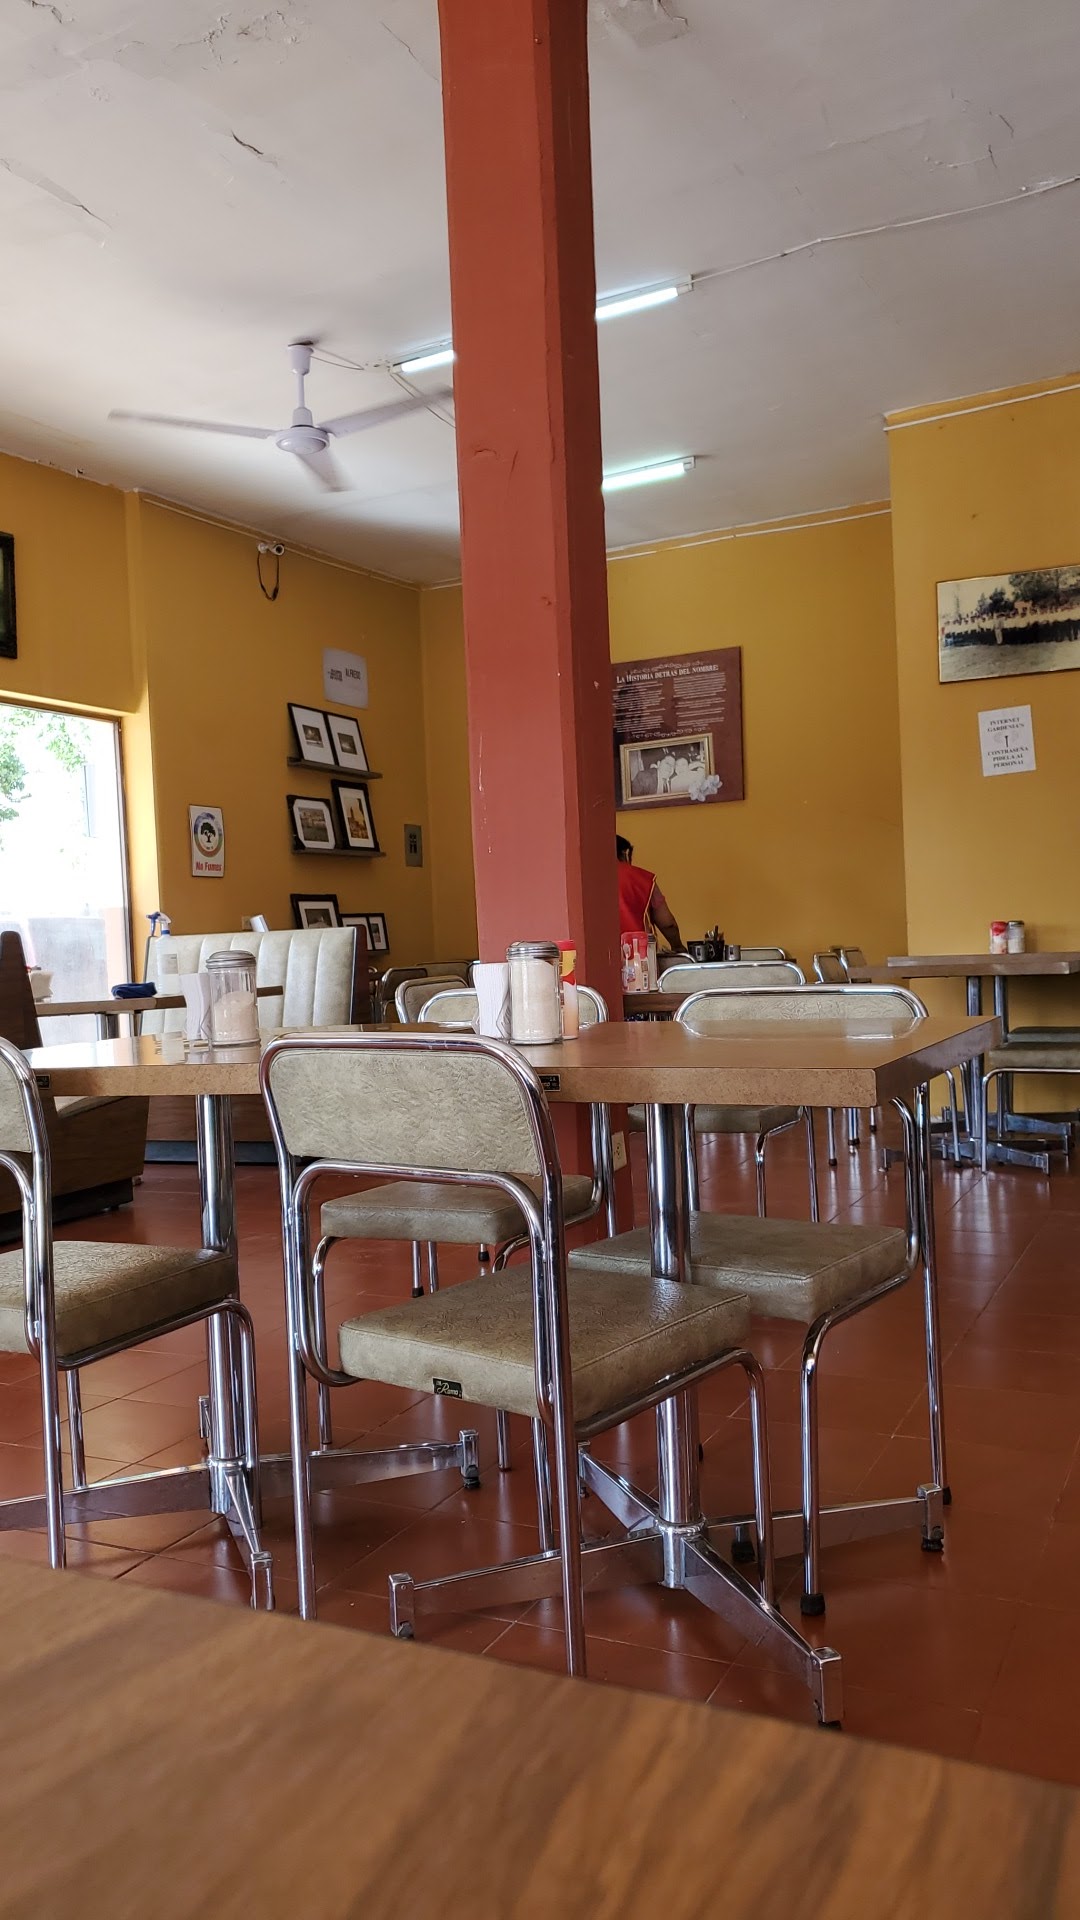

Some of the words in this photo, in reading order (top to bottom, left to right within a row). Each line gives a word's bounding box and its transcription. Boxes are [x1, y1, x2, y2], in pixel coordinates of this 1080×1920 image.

[616, 676, 626, 684] LA
[626, 672, 654, 682] HISTORIA
[990, 717, 1020, 726] INTERNET
[993, 760, 1024, 769] PERSONAL
[195, 861, 204, 871] No
